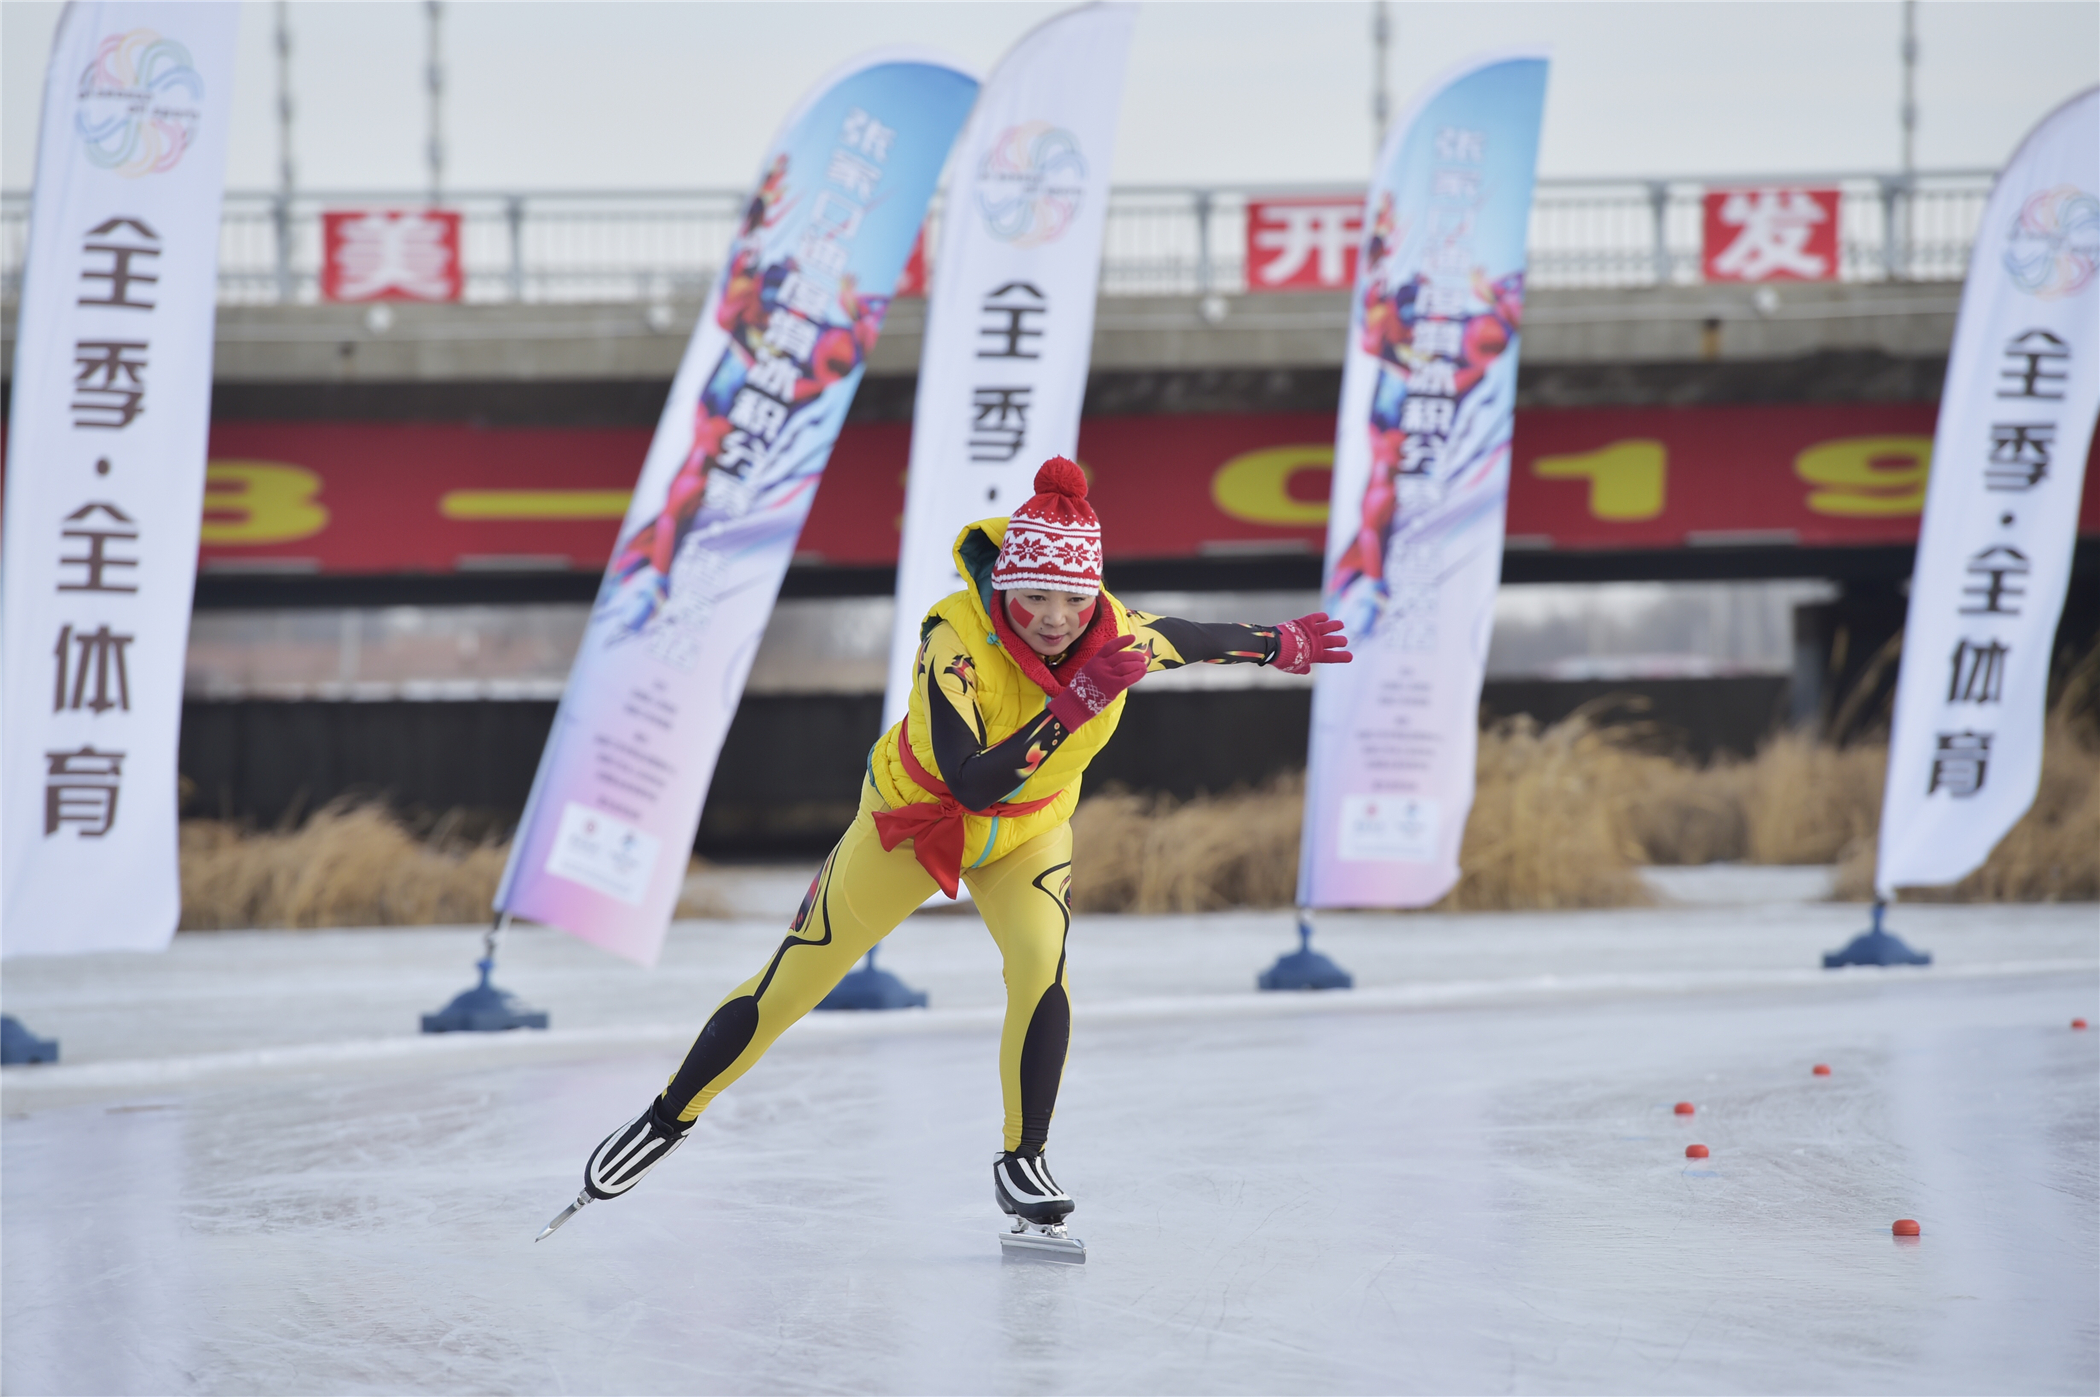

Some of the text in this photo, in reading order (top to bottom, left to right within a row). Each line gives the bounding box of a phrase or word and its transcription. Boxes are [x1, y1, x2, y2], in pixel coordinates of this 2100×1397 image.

[332, 190, 1829, 301] 美 开 发
[965, 280, 1048, 501] 全季·
